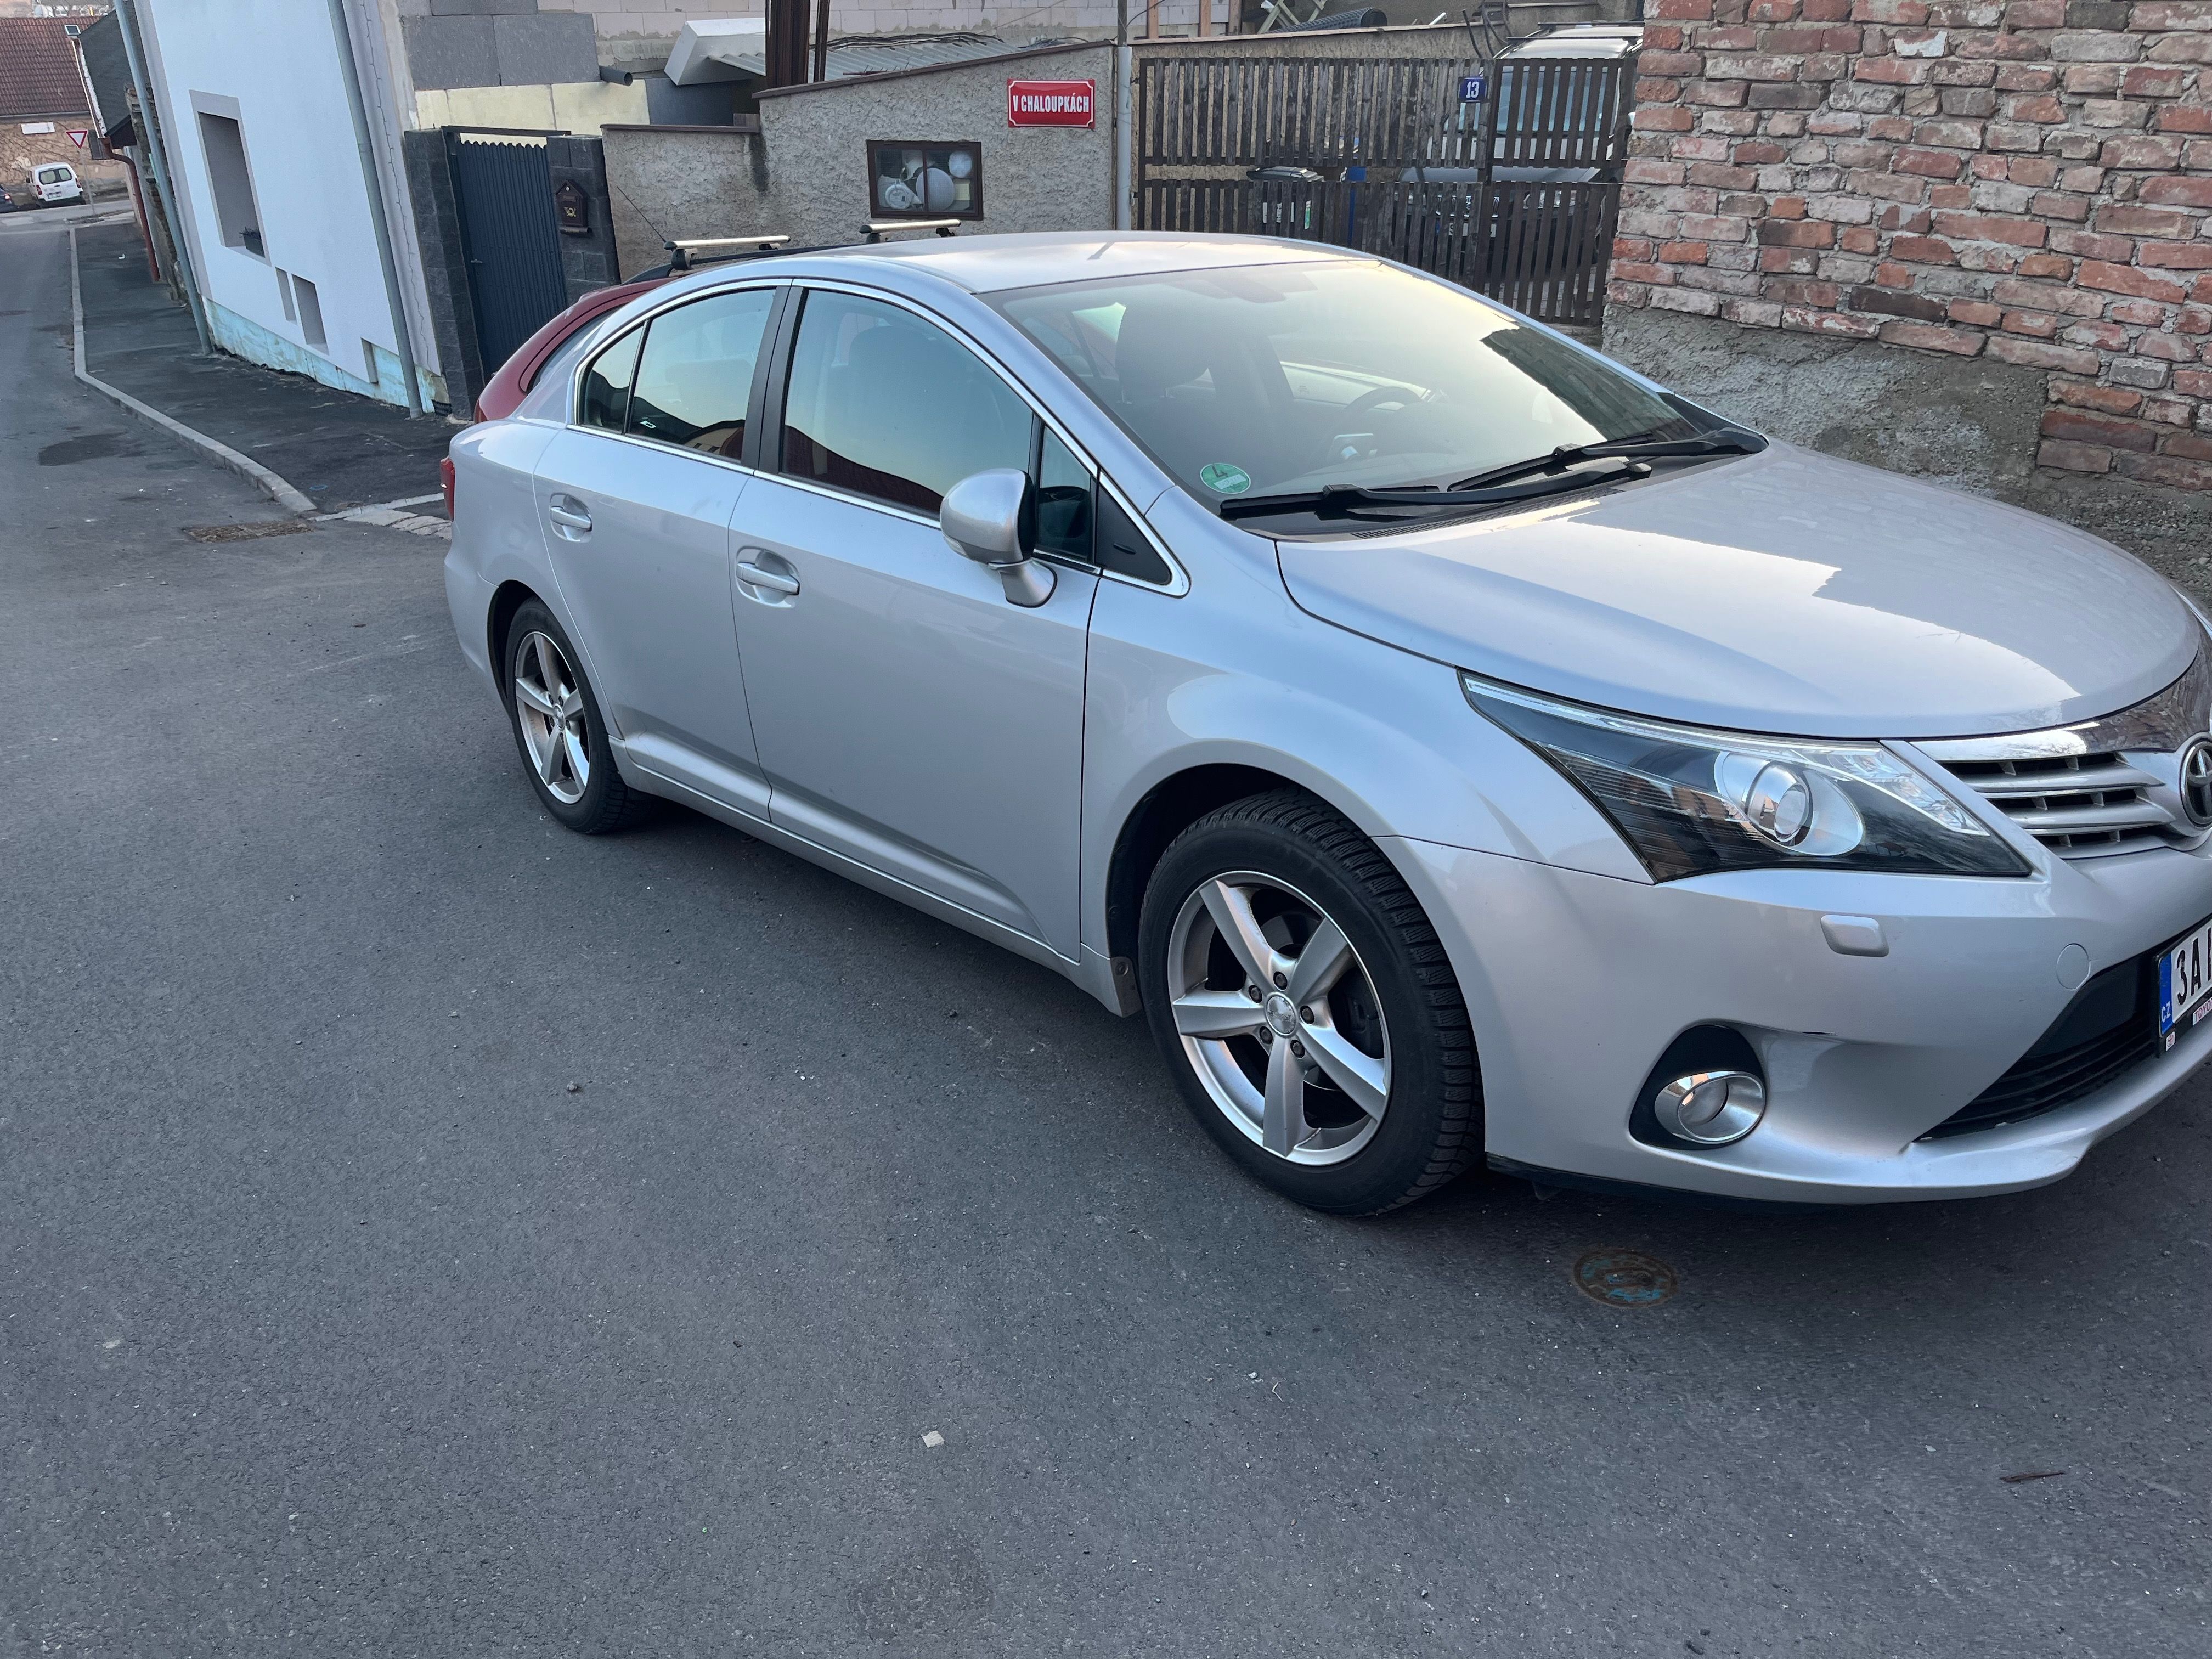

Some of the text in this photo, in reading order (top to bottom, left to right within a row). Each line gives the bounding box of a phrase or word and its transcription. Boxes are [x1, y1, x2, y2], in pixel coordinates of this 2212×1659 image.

[1466, 81, 1480, 98] 13
[1013, 92, 1090, 113] V CHALOUPKÁCH
[2176, 927, 2212, 1005] 3A
[2161, 1001, 2171, 1023] CZ
[2195, 998, 2212, 1022] TOYO
